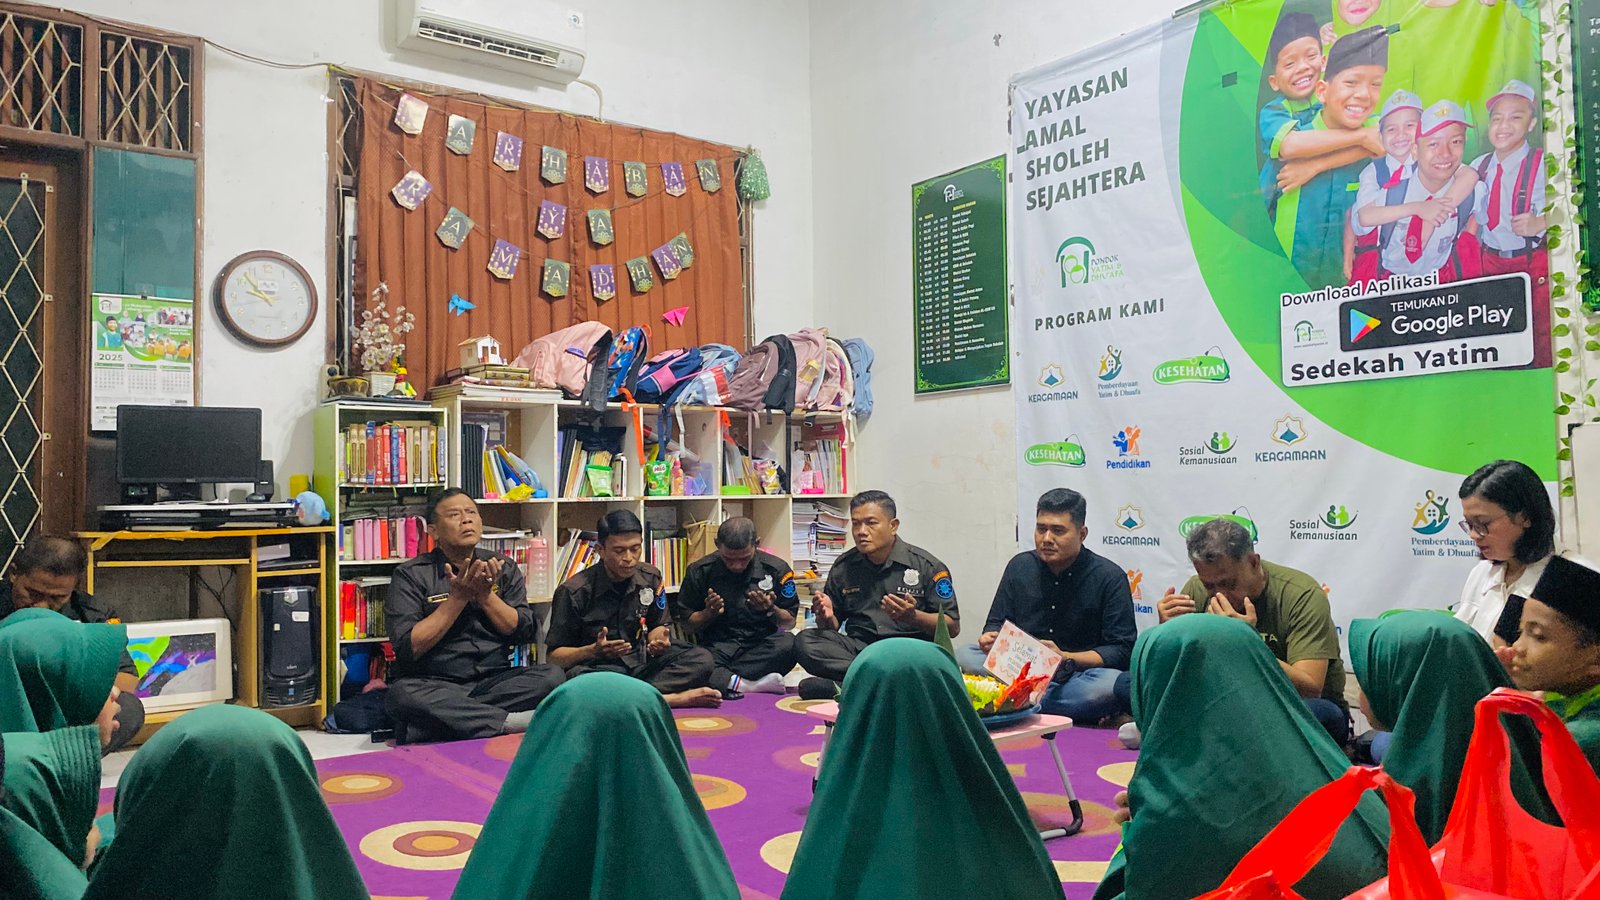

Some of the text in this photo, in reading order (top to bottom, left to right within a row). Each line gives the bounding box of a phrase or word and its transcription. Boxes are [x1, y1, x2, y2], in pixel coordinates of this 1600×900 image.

[1025, 67, 1128, 120] YAYASAN
[1025, 115, 1087, 150] AMAL
[1026, 138, 1109, 181] SHOLEH
[1026, 161, 1146, 211] SEJAHTERA
[1282, 270, 1438, 307] Download Aplikasi
[1390, 293, 1459, 312] TEMUKAN DI
[1034, 297, 1165, 331] PROGRAM KAMI
[1391, 304, 1514, 335] Google Play
[99, 353, 123, 362] 2025
[1291, 343, 1499, 382] Sedekah Yatim
[1158, 363, 1225, 380] KESEHATAN
[1028, 391, 1078, 403] KEAGAMAAN
[1028, 448, 1082, 462] KESEHATAN
[1179, 446, 1205, 457] Sosial
[1255, 449, 1326, 463] KEAGAMAAN
[1106, 459, 1151, 470] Pendidikan
[1179, 455, 1237, 466] Kemanusiaan
[1289, 519, 1320, 530] Sosial
[1102, 535, 1160, 547] KEAGAMAAN
[1290, 529, 1357, 541] Kemanusiaan
[1411, 537, 1476, 548] Pemberdayaan
[1412, 548, 1435, 556] Yatim
[1438, 549, 1445, 557] &
